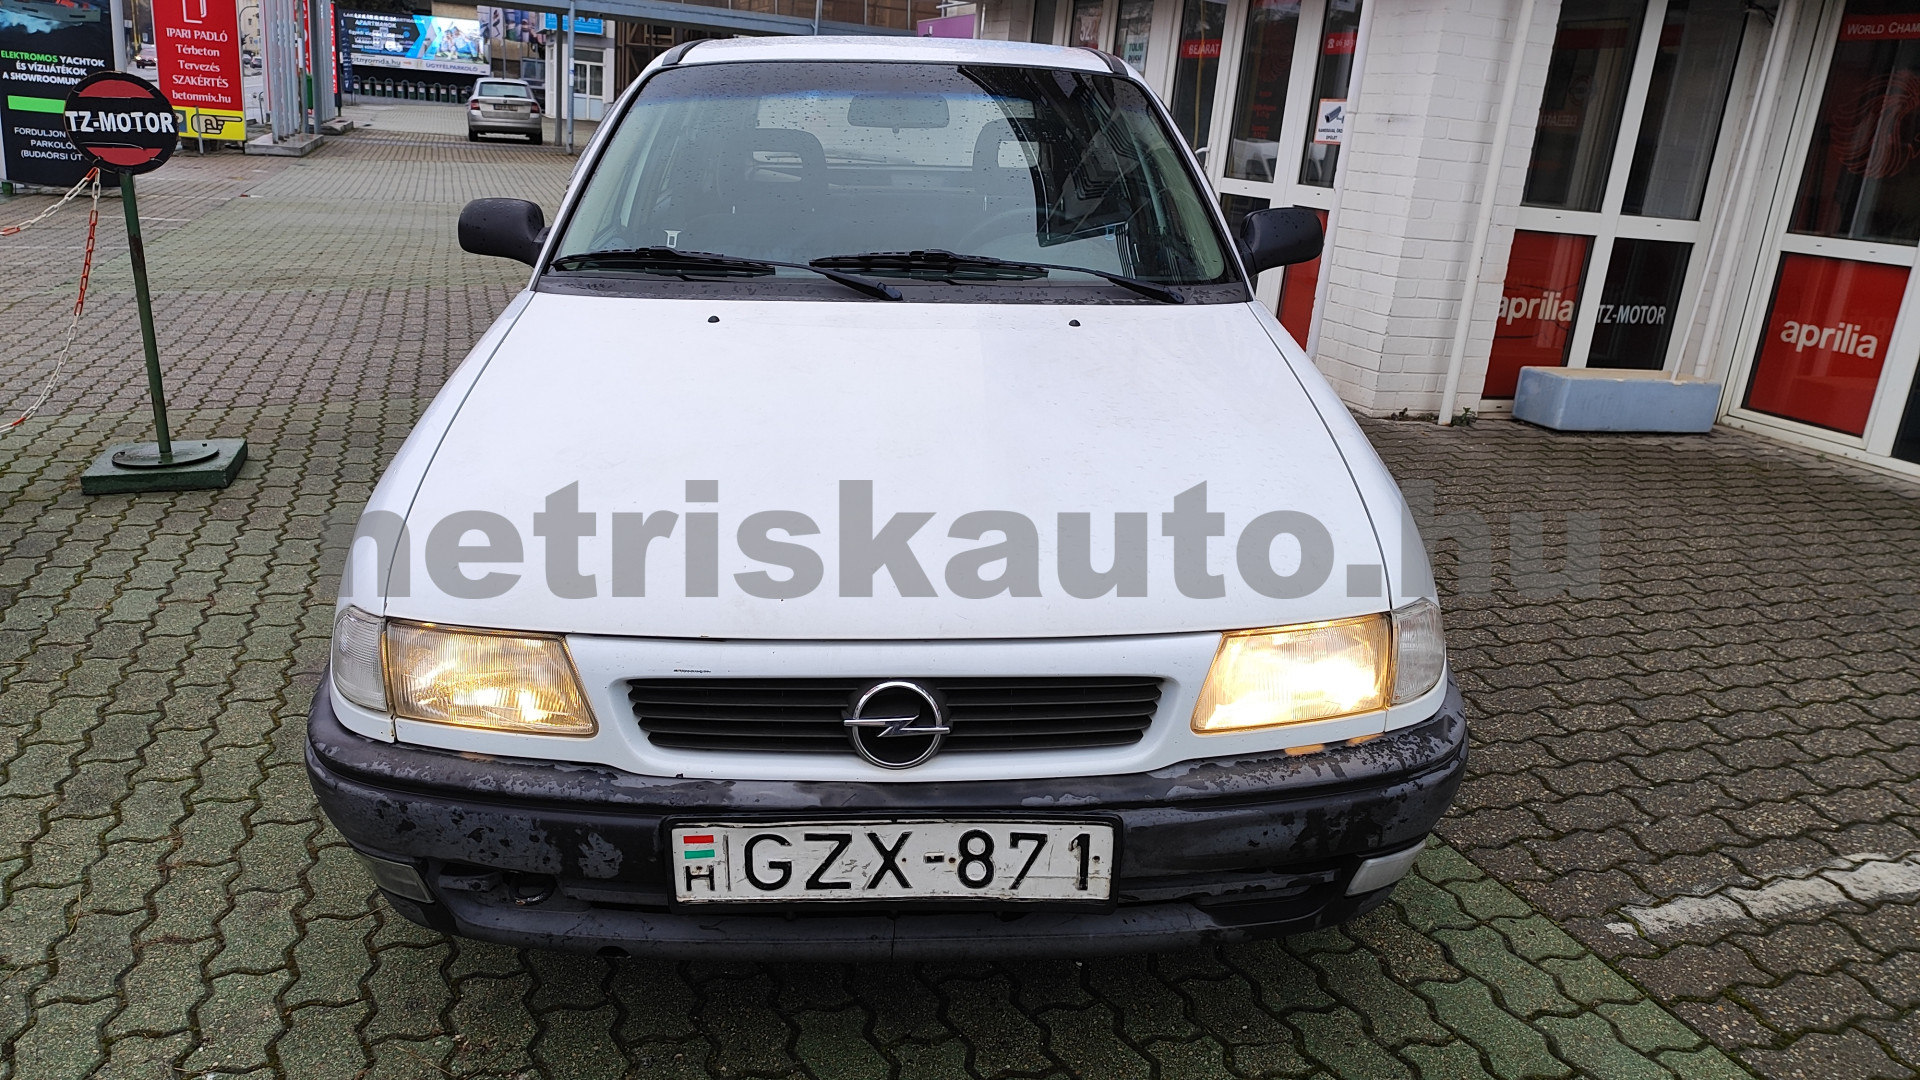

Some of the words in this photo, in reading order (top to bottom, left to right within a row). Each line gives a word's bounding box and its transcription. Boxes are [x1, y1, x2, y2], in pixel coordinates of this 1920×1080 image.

[166, 27, 191, 39] IPARI
[194, 29, 228, 42] PADLÓ
[1847, 23, 1885, 35] WORLD
[1888, 21, 1920, 34] CHAM
[175, 44, 220, 57] Térbeton
[1, 49, 58, 63] ELEKTROMOS
[59, 55, 105, 67] YACHTOK
[16, 60, 27, 70] ÉS
[27, 61, 88, 76] VÍZIJÁTÉKOK
[178, 59, 220, 72] Tervezés
[3, 71, 9, 80] A
[10, 72, 81, 85] SHOWROOMUN
[172, 74, 229, 88] SZAKÉRTÉS
[172, 90, 231, 104] betonmix.hu
[65, 111, 175, 133] TZ-MOTOR
[14, 126, 66, 138] FORDULJON
[1597, 304, 1667, 325] TZ-MOTOR
[1780, 320, 1878, 359] aprilia
[685, 865, 716, 892] H
[743, 829, 1091, 892] GZX-871
